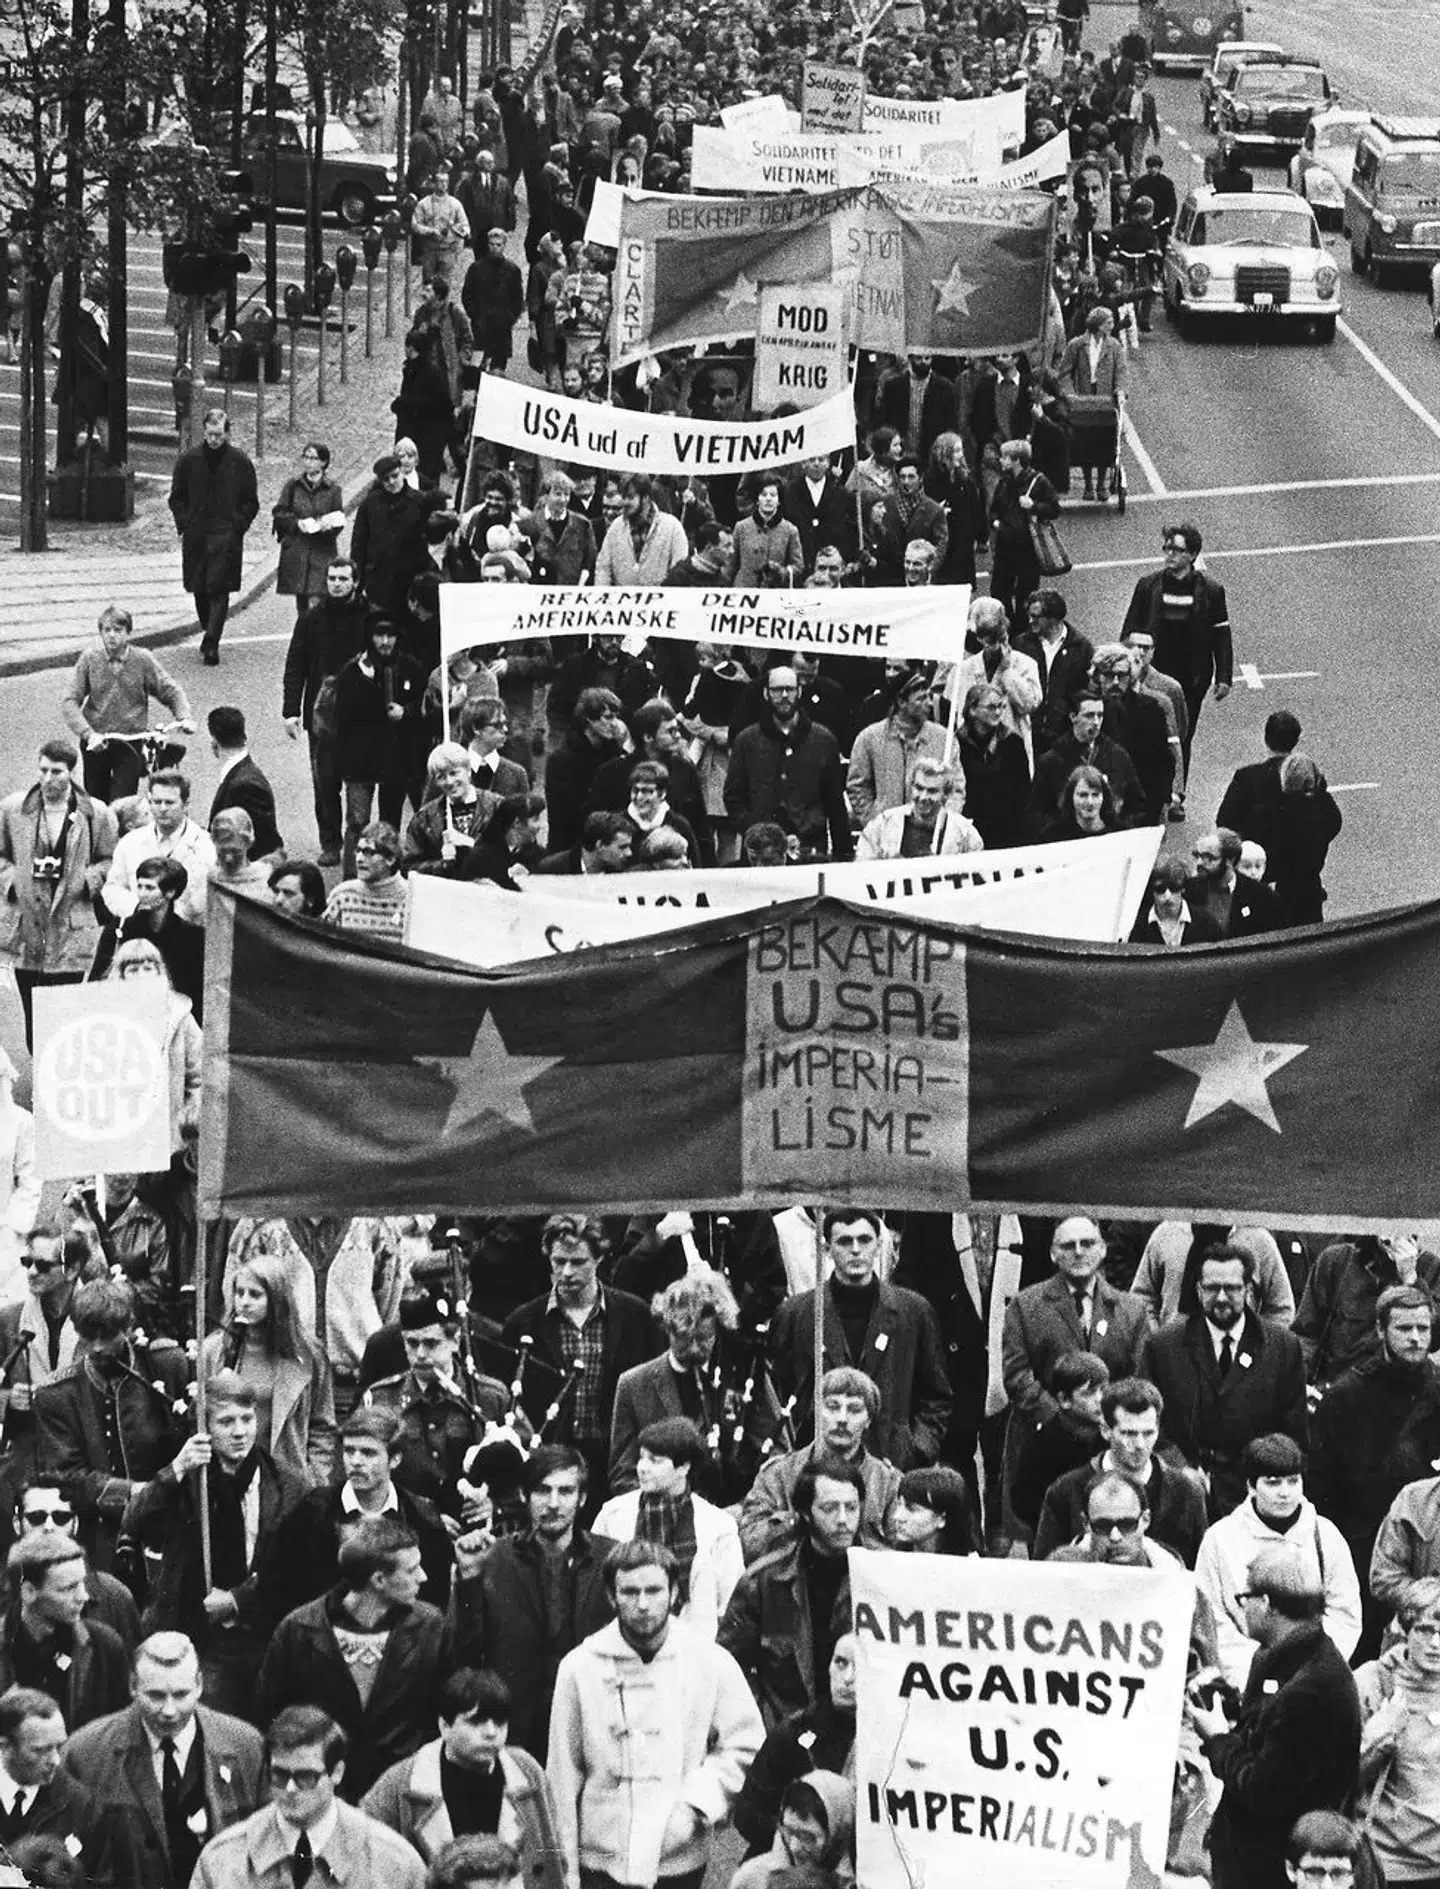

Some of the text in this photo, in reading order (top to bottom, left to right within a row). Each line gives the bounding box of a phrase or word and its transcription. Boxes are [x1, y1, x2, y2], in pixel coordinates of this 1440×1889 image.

[864, 101, 941, 125] SOLIDARITET
[752, 140, 836, 161] SOLIDARITET
[777, 303, 829, 333] MOD
[778, 362, 828, 390] KRIG
[523, 401, 805, 463] USA ud af VIETNAM
[701, 593, 760, 609] DEN
[511, 609, 891, 646] AMERIKANSKE IMPERIALISME
[755, 917, 953, 983] BEKÆMP
[54, 1022, 152, 1083] USA
[57, 1083, 149, 1130] OUT
[854, 1602, 1165, 1670] AMERICANS
[898, 1661, 1146, 1720] AGAINST
[968, 1726, 1070, 1782] U.S.
[867, 1782, 1143, 1864] IMPERIALISM
